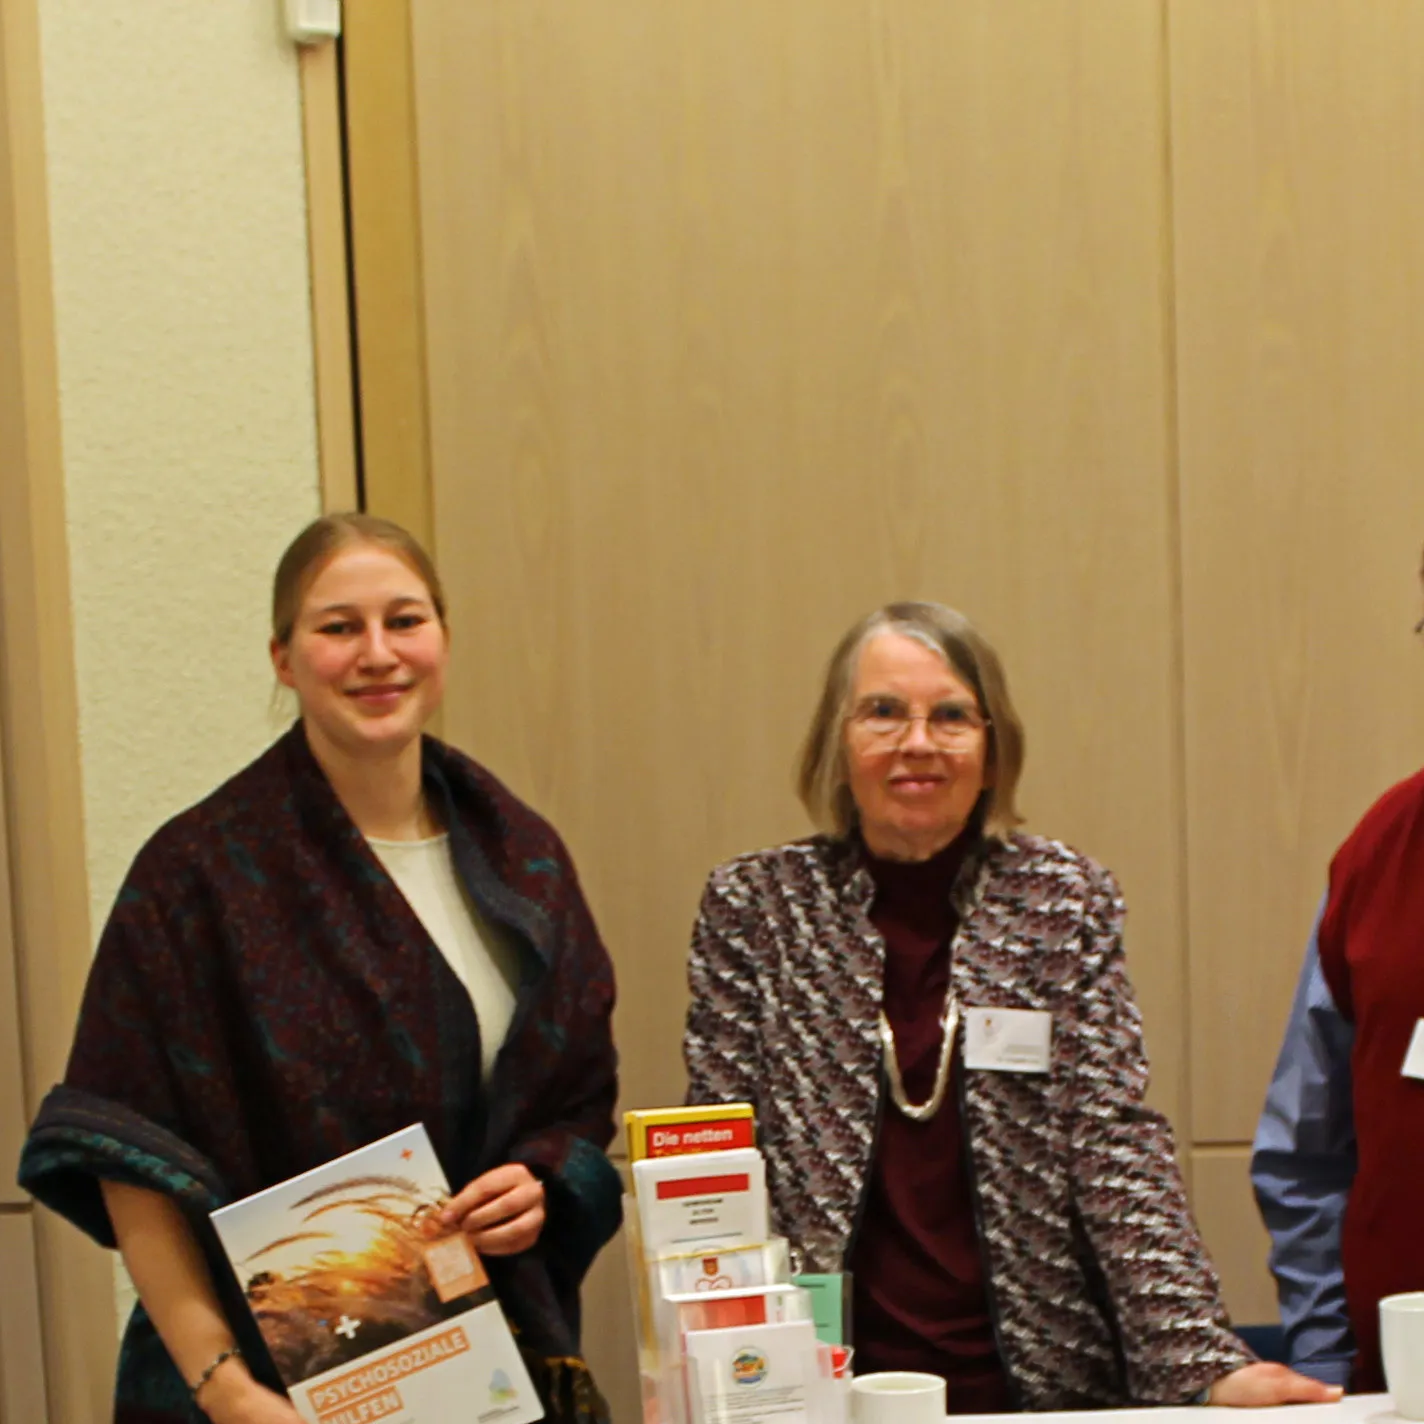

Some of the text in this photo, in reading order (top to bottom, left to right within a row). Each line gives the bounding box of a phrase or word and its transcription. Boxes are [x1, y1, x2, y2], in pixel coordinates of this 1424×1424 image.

[653, 1128, 734, 1147] Die netten
[312, 1330, 468, 1409] PSYCHOSOZIALE
